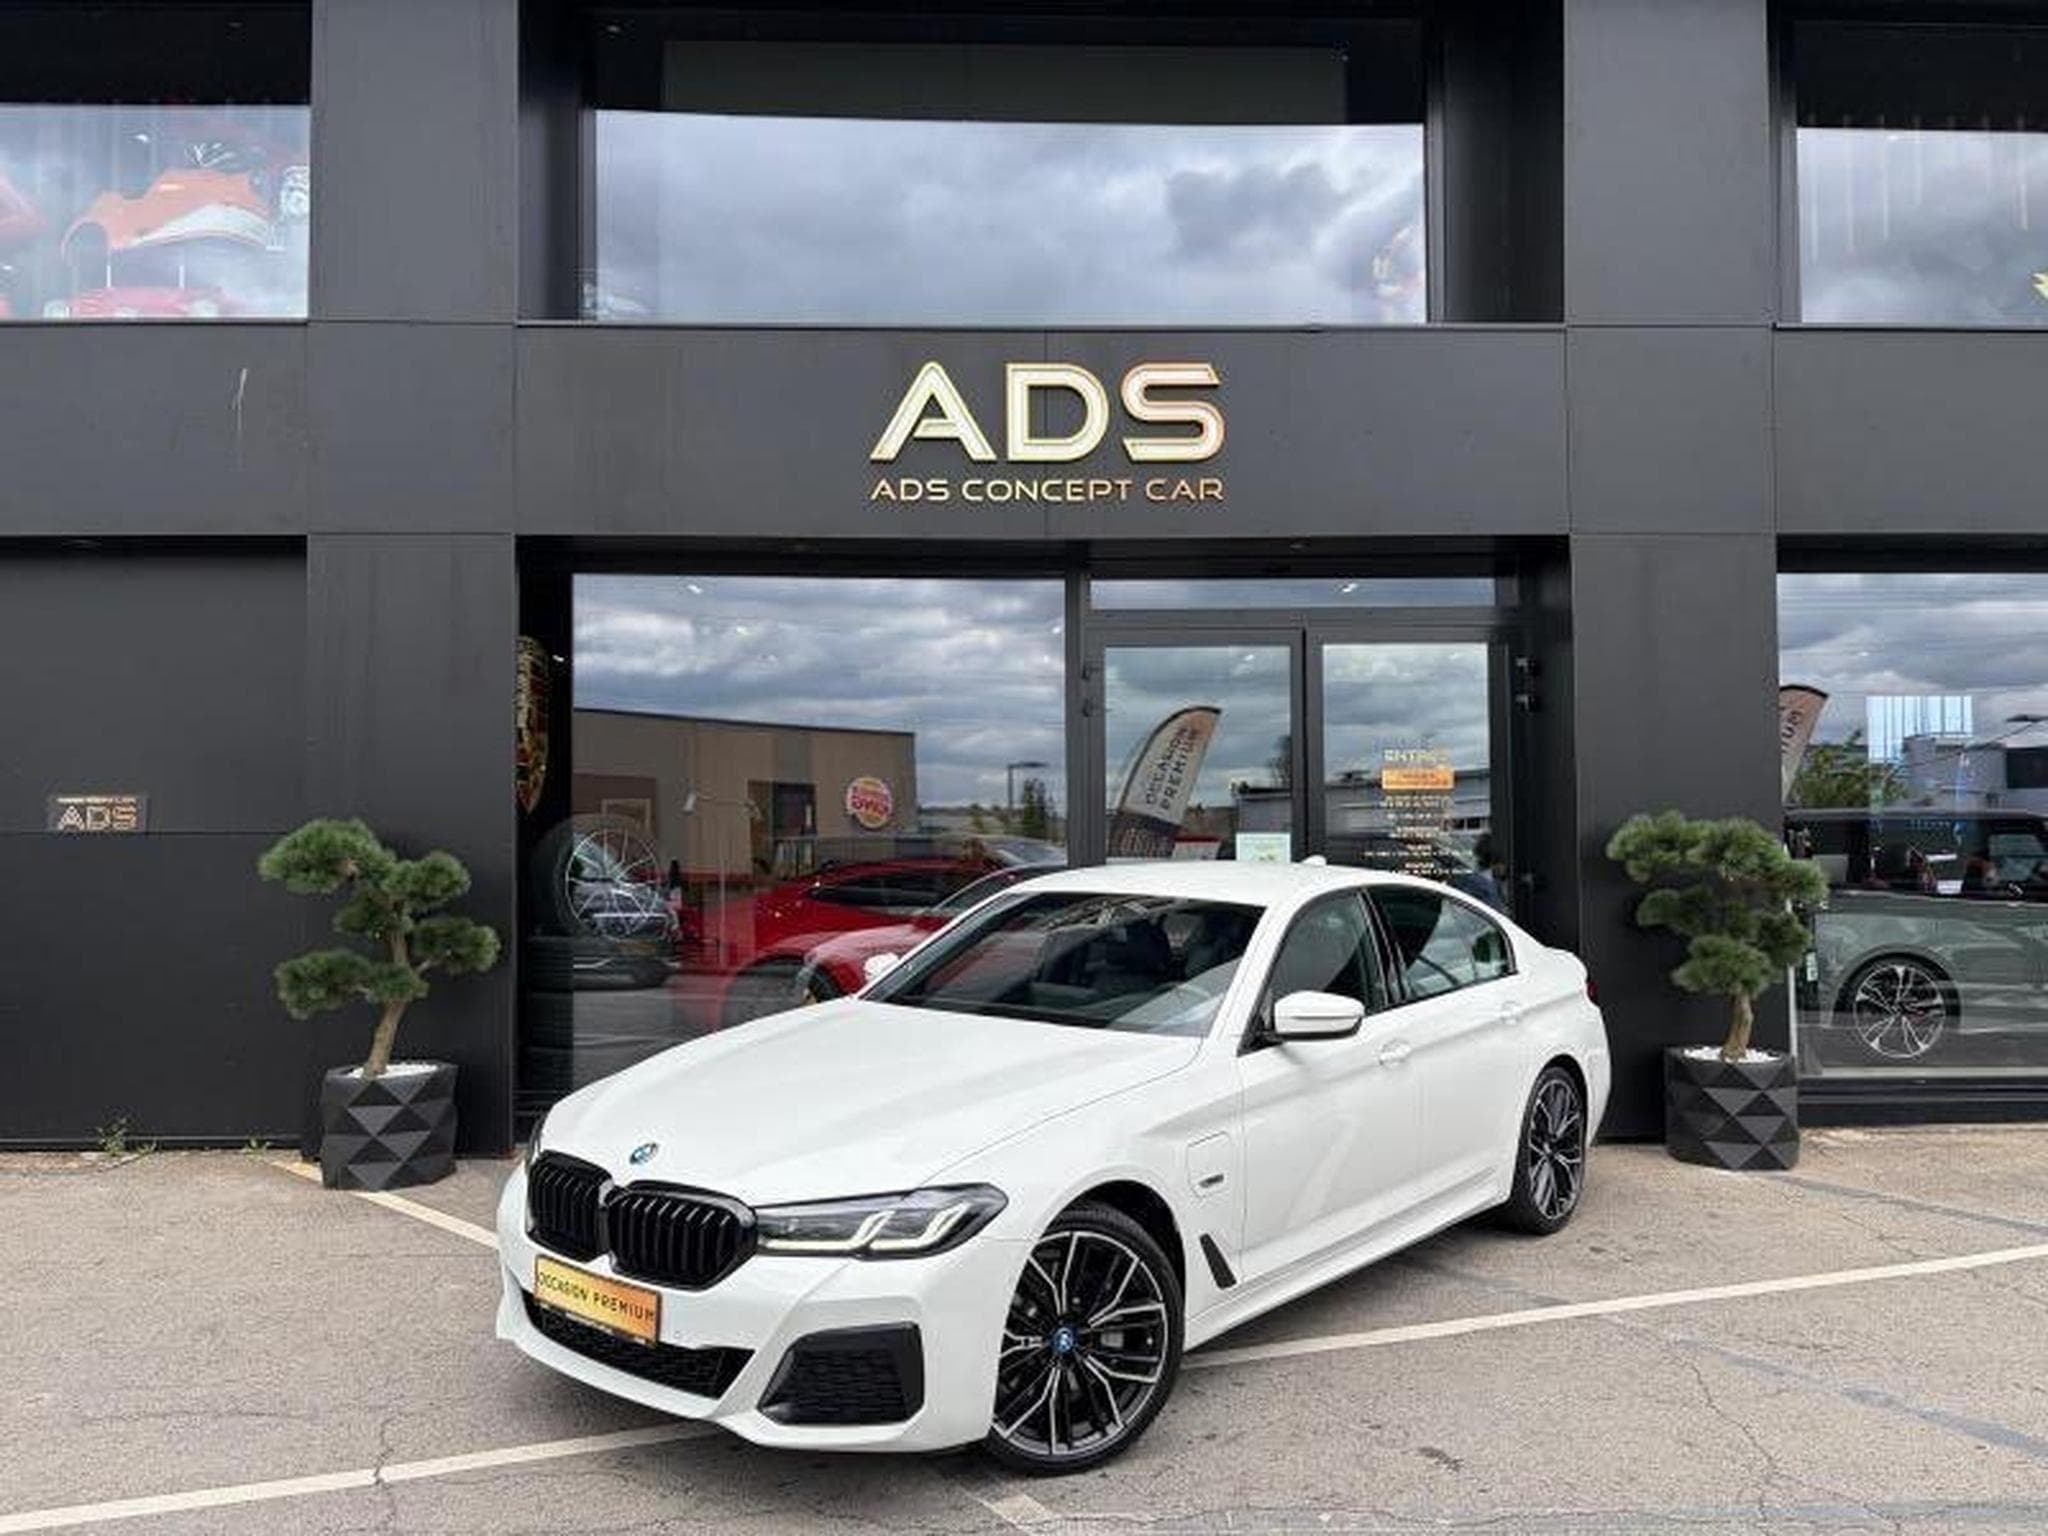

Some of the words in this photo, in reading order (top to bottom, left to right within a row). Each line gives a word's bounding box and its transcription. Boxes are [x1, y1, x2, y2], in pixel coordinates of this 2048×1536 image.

[869, 360, 1226, 464] ADS
[870, 479, 950, 502] ADS
[961, 479, 1132, 502] CONCEPT
[1145, 479, 1225, 502] CAR
[57, 805, 137, 831] ADS
[538, 1272, 589, 1300] OCCASION
[593, 1292, 655, 1321] PREMIUM
